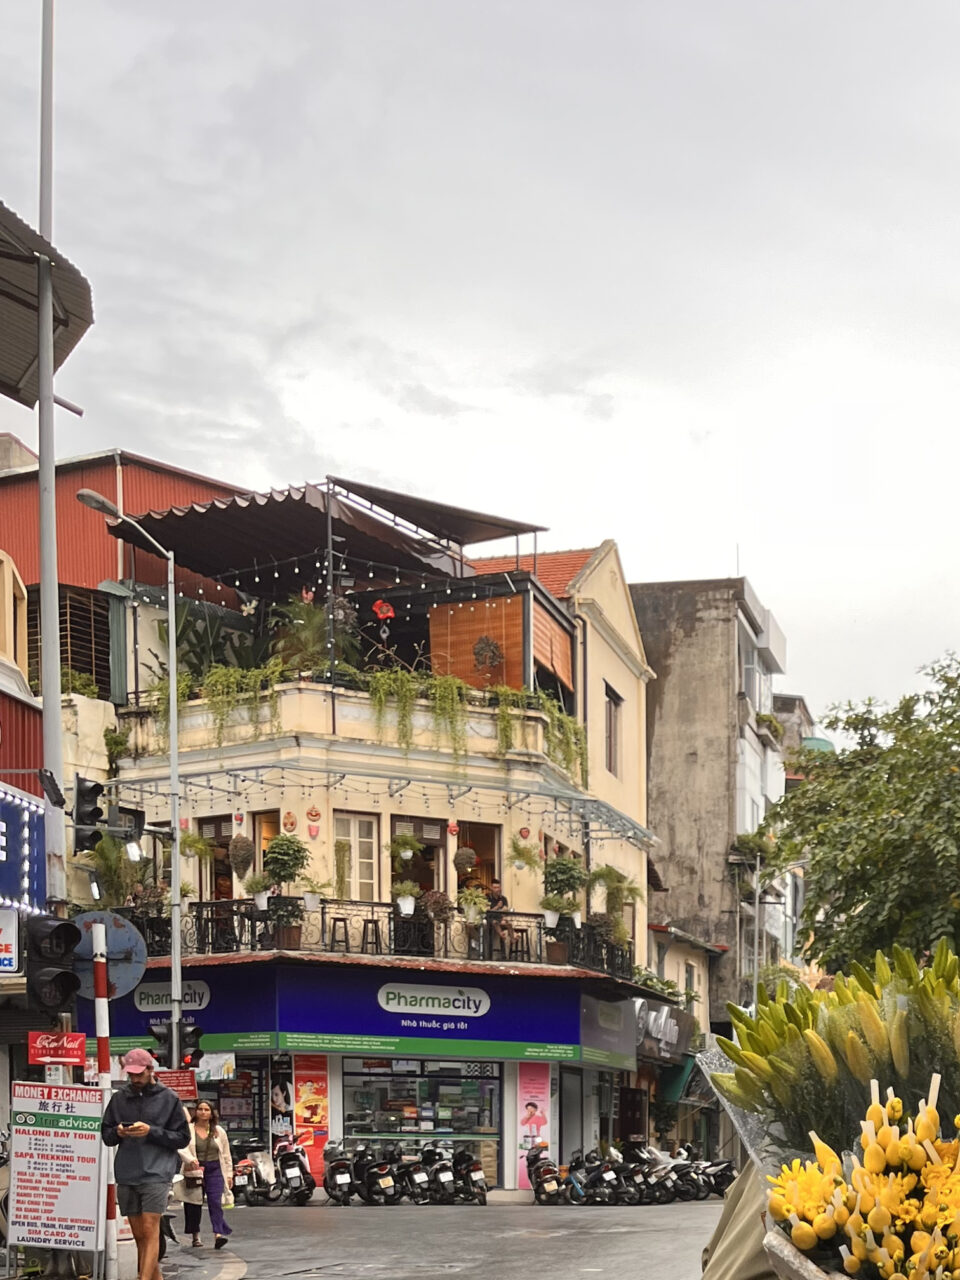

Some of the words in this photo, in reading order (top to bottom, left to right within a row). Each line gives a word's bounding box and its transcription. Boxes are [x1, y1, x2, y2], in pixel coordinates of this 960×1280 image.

[139, 991, 205, 1006] Pharmcity
[386, 992, 482, 1014] Pharmacity
[15, 1086, 49, 1099] MONEY
[52, 1089, 102, 1103] EXCHANGE
[39, 1101, 76, 1114] 旅行社
[41, 1117, 100, 1130] tripadvisor
[15, 1128, 51, 1137] HALONG
[54, 1130, 70, 1139] BAY
[74, 1132, 96, 1141] TOUR
[37, 1153, 74, 1162] TREKKING
[77, 1156, 96, 1164] TOUR
[17, 1236, 52, 1244] LAUNDRY
[54, 1238, 86, 1247] SERVICE
